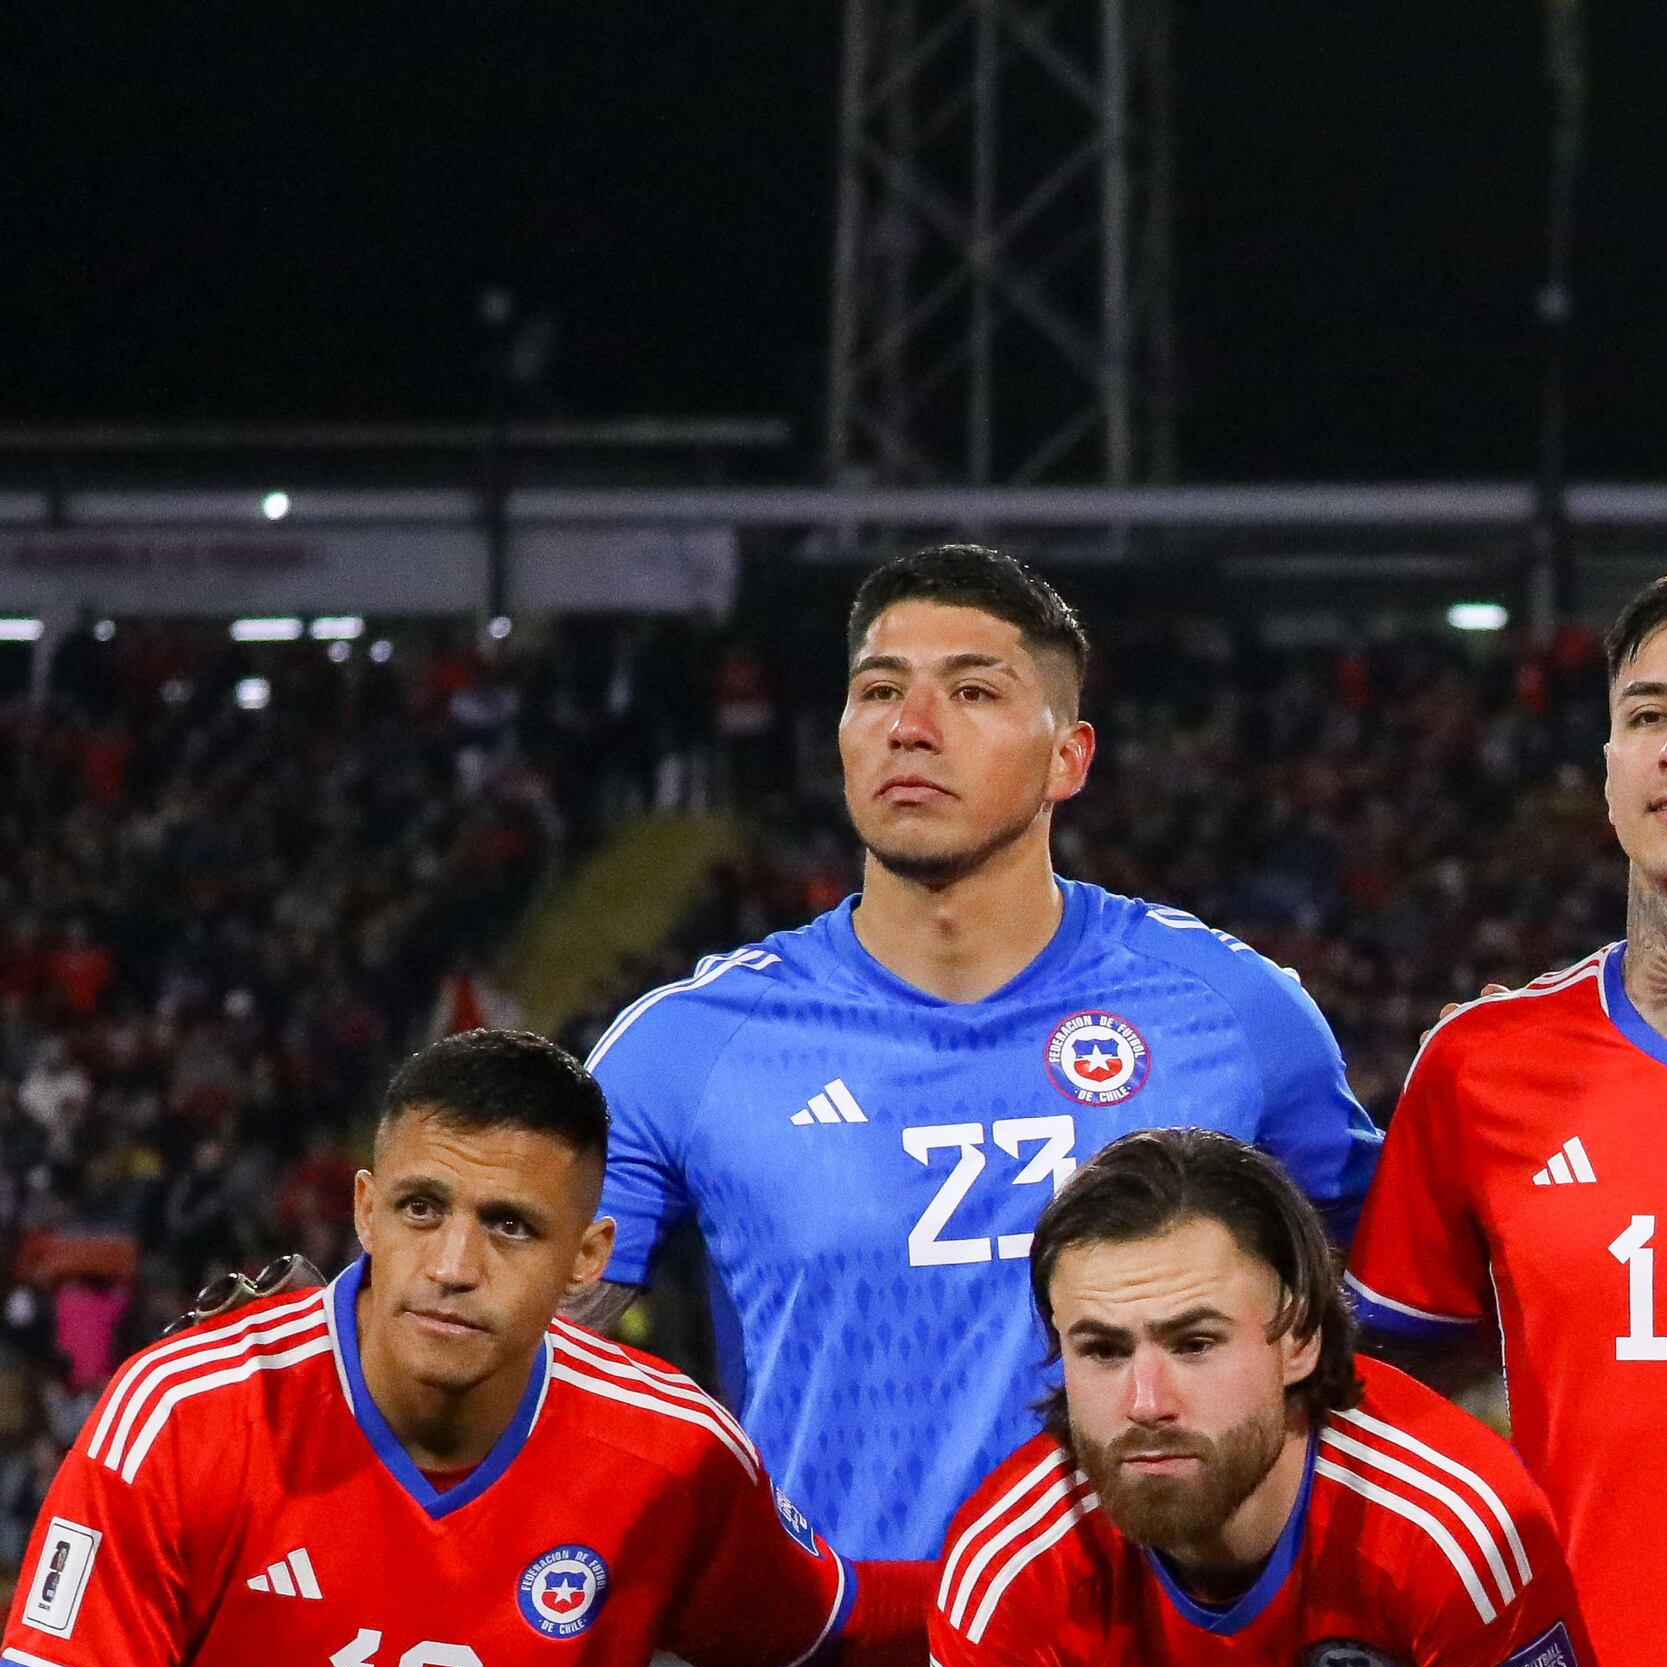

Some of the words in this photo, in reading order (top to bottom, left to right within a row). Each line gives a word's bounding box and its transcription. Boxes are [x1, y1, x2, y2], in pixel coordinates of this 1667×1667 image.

[1049, 1015, 1093, 1063] FEDERACION
[1099, 1015, 1114, 1028] DE
[1117, 1023, 1146, 1059] FUTBOL
[1077, 1090, 1093, 1102] DE
[1099, 1086, 1130, 1102] CHILE
[902, 1115, 1077, 1267] 23
[521, 1550, 569, 1591] FEDERACION
[575, 1551, 590, 1562] DE
[541, 1621, 555, 1633] DE
[559, 1619, 585, 1635] CHILE
